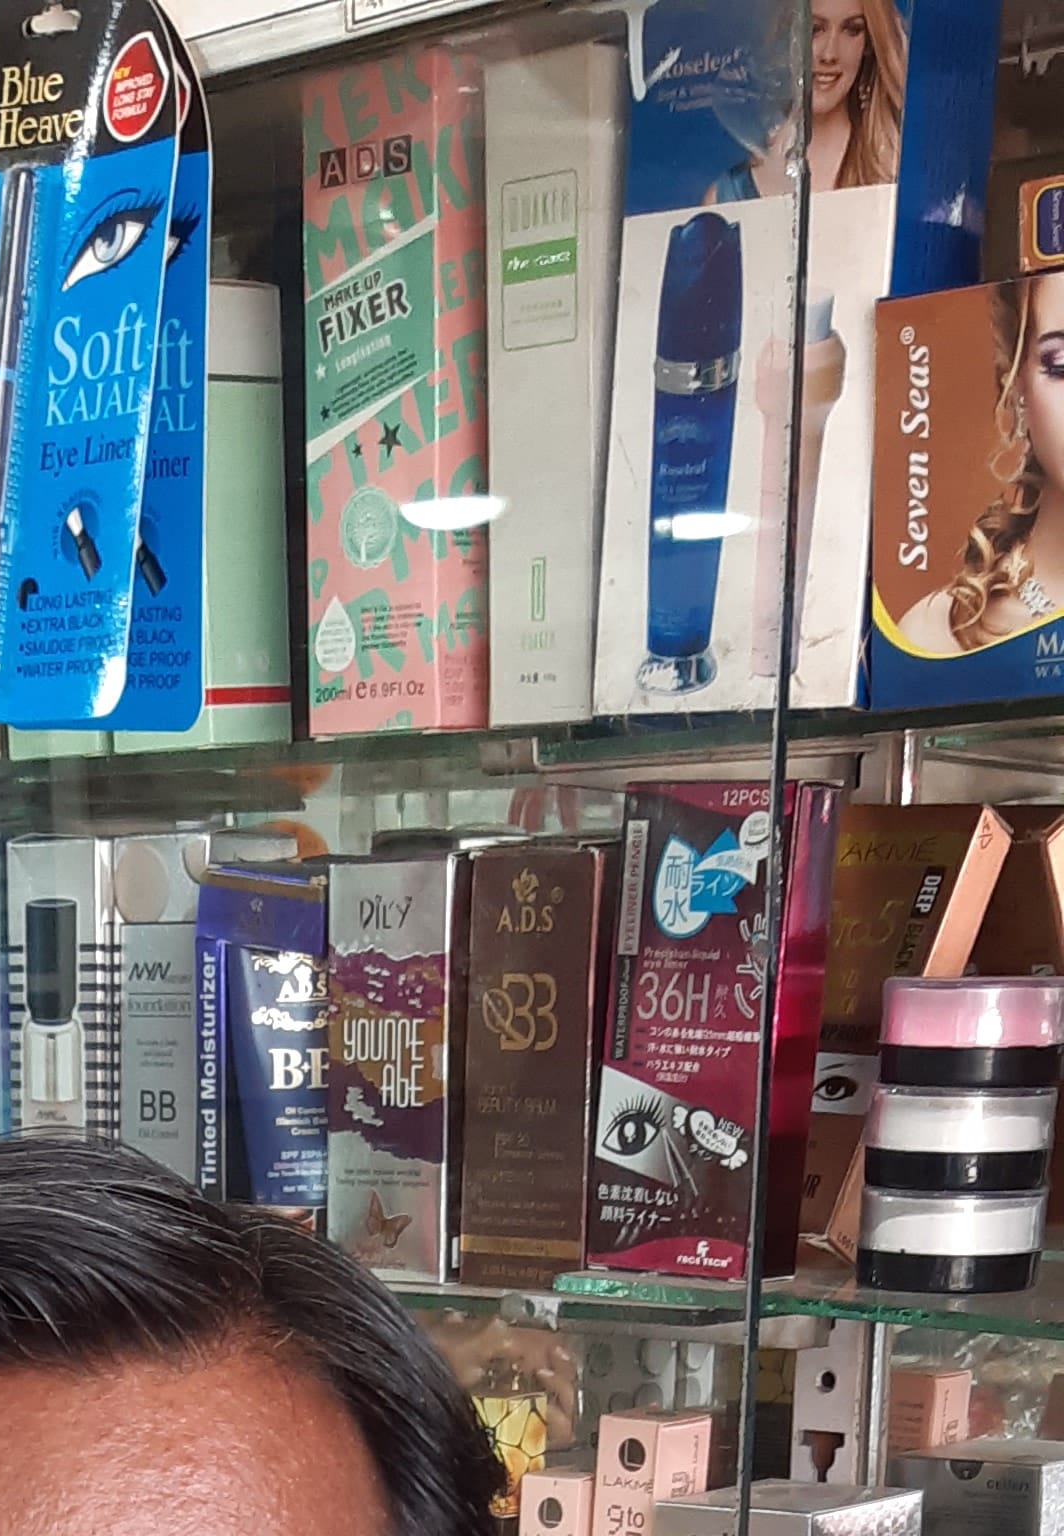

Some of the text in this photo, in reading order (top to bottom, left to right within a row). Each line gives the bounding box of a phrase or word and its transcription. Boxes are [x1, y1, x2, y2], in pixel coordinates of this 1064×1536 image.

[658, 48, 742, 80] oseleaf
[0, 62, 64, 107] Blue
[320, 136, 412, 188] ADS
[323, 271, 383, 312] MAKE UP
[318, 280, 409, 354] FIXER
[48, 302, 147, 387] Soft
[45, 377, 142, 427] KAJAL
[40, 433, 135, 479] Eye Liner
[899, 448, 930, 571] Seven
[28, 589, 113, 612] LONG LASTING
[68, 612, 104, 631] BLACK
[135, 628, 176, 646] BLACK
[67, 658, 102, 674] PROO
[149, 651, 192, 668] PROOF
[139, 674, 182, 689] PROOF
[723, 789, 771, 807] 12PCS
[840, 836, 937, 863] AKMÉ
[691, 874, 742, 898] ライン
[496, 905, 554, 933] A.D.S
[894, 875, 942, 970] DEEP BLACK
[636, 971, 712, 1024] 36H
[199, 950, 218, 1190] Tinted Moisturizer
[140, 1090, 177, 1123] BB
[717, 1117, 745, 1139] NEW
[603, 1474, 654, 1494] LAKMÉ
